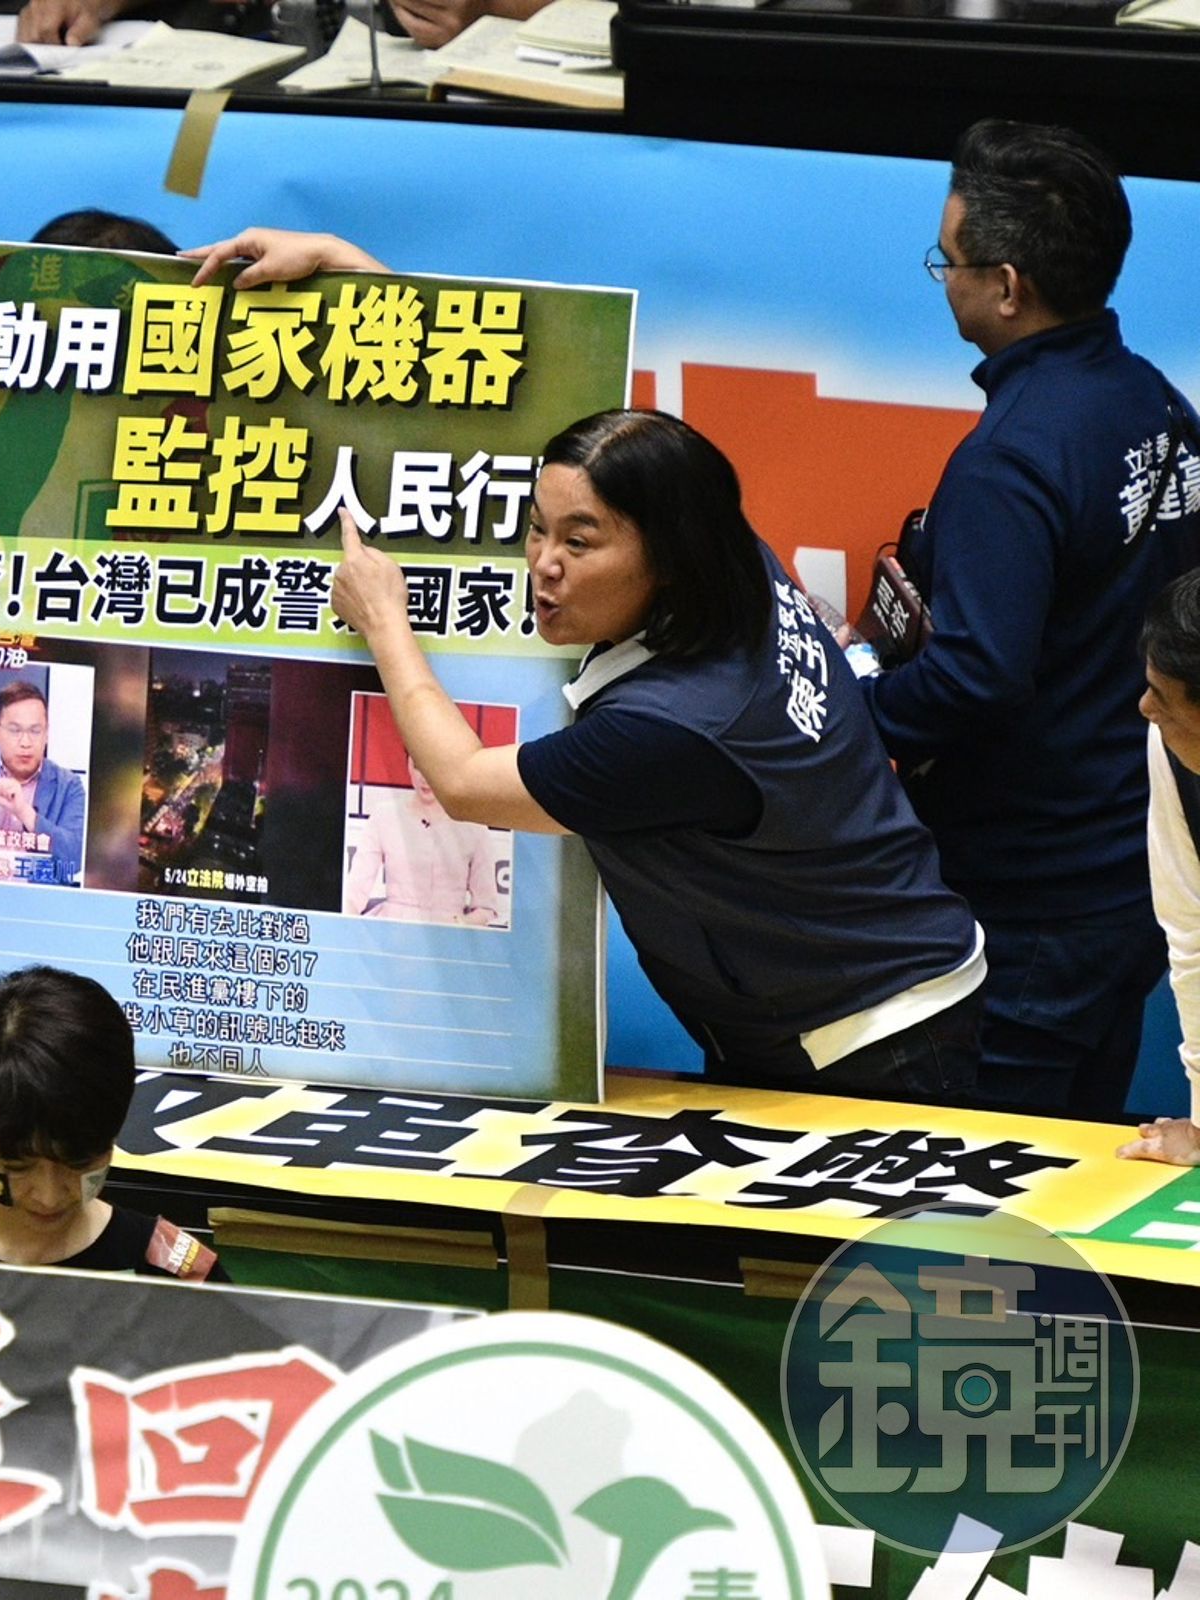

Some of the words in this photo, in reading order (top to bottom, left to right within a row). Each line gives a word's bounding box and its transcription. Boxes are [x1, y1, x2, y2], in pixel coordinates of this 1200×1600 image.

[106, 416, 544, 538] 監控人民行
[137, 900, 310, 944] 我們有去比對過
[126, 934, 318, 977] 他跟原來這個517
[133, 968, 307, 1013] 在民進黨樓下的
[169, 1042, 269, 1077] 也不同人
